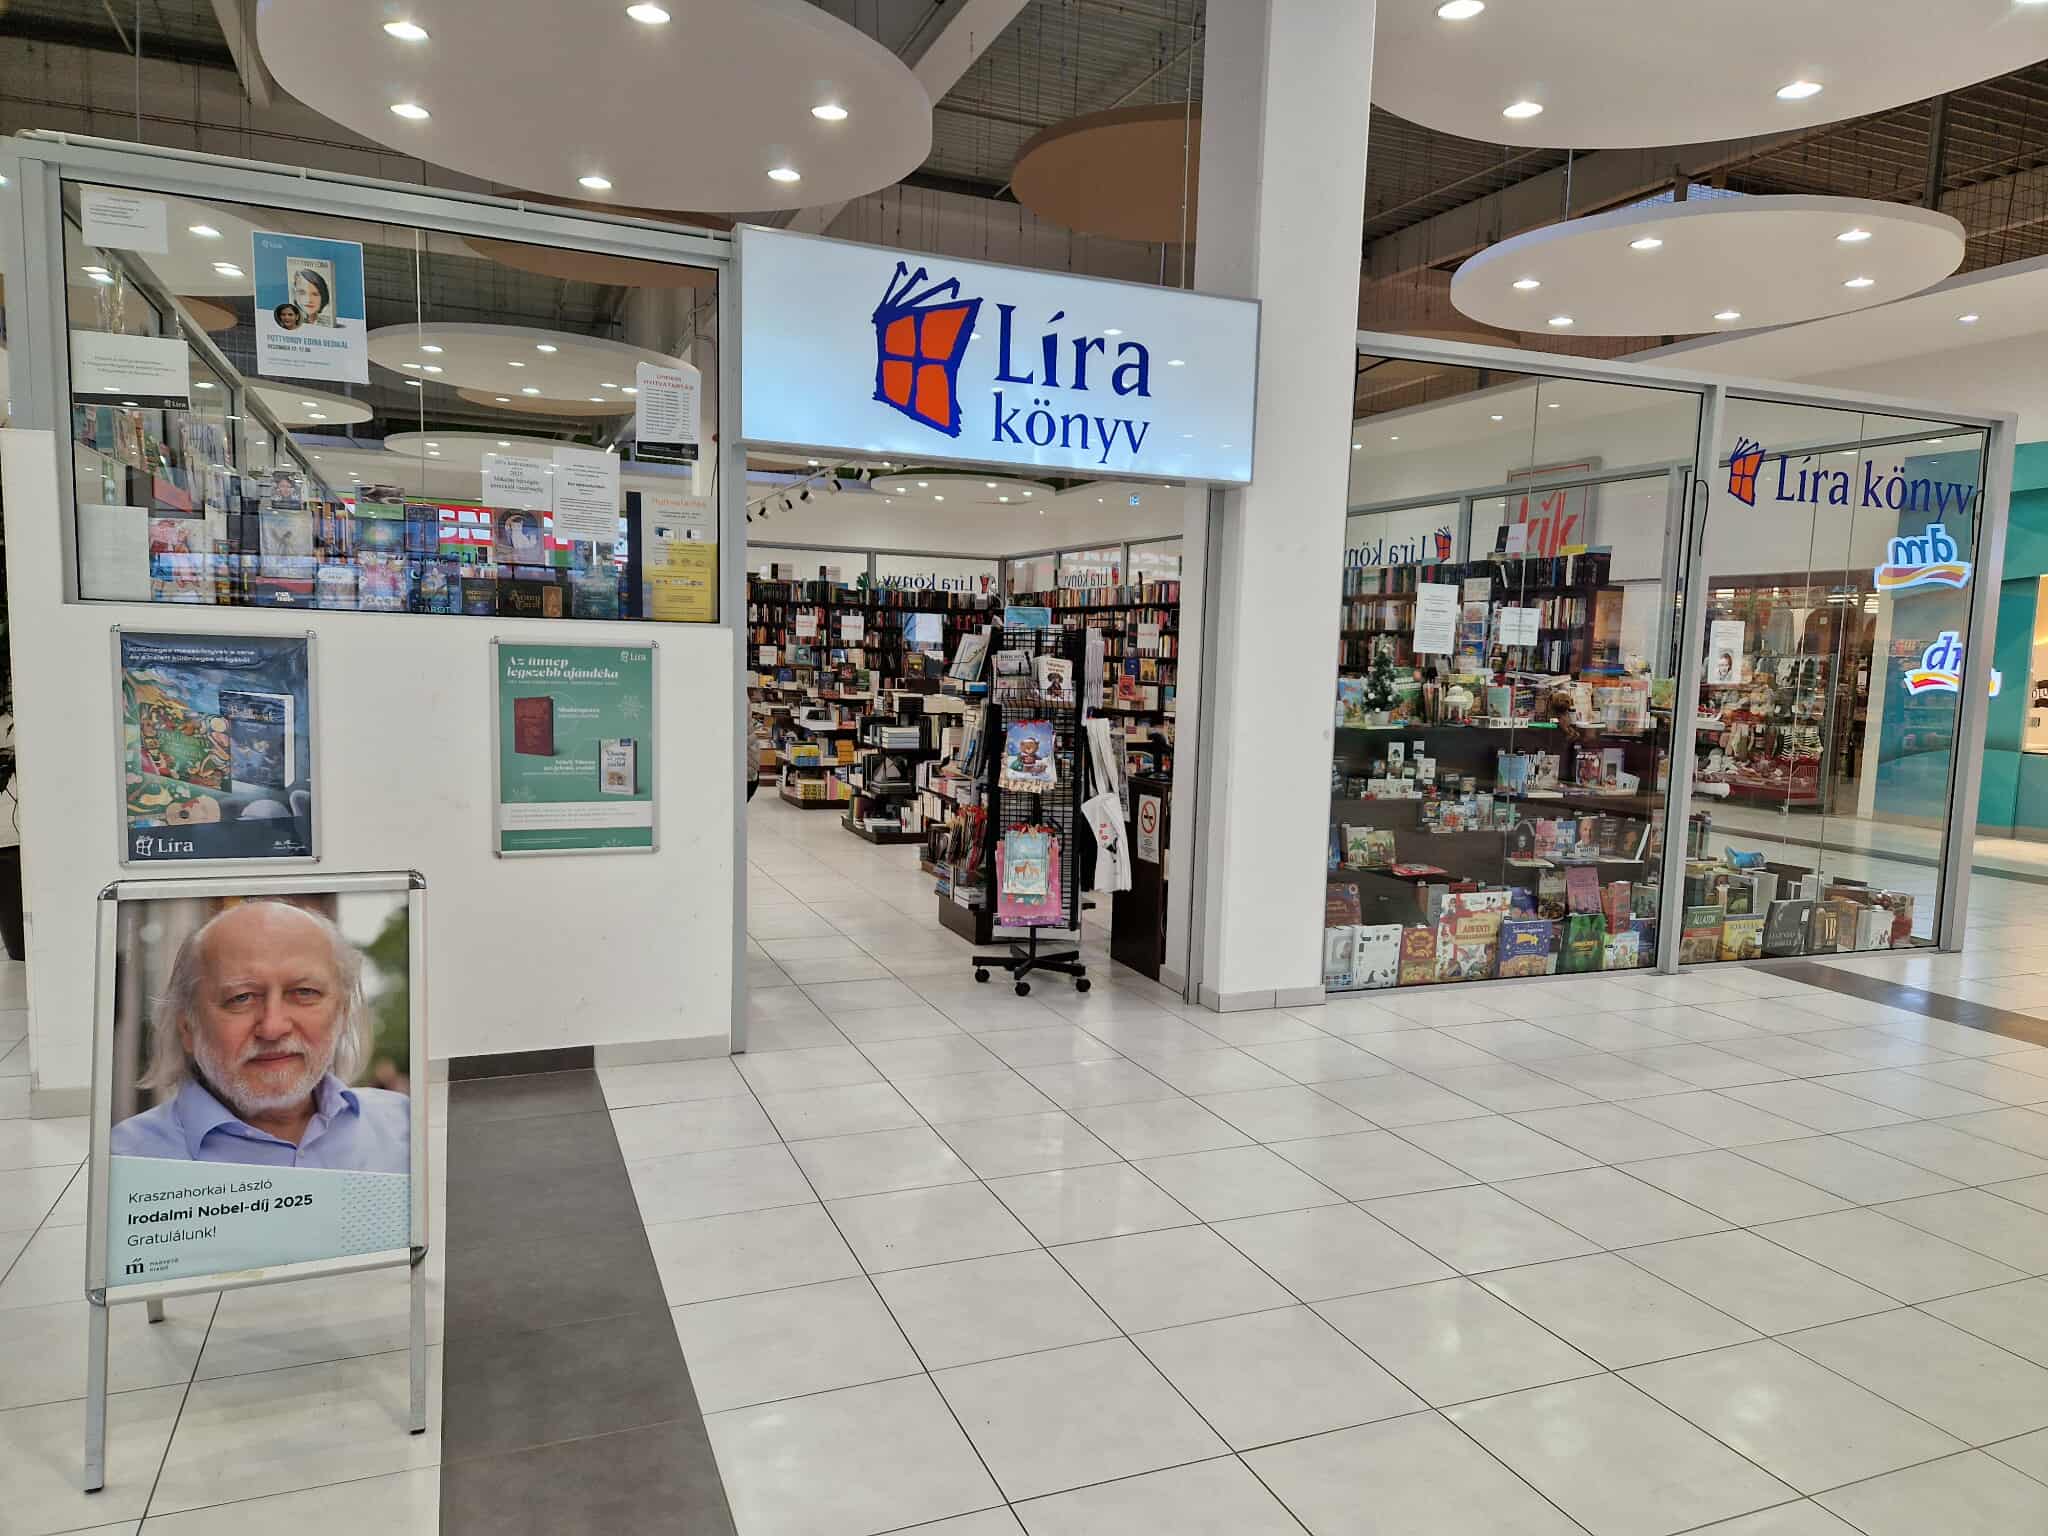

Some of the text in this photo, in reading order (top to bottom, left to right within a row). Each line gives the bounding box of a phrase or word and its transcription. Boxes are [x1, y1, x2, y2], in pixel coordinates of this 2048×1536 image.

[993, 302, 1151, 397] Líra
[992, 391, 1151, 464] könyv
[1776, 455, 1974, 525] Líra könyv
[507, 666, 619, 681] legszebb ajándéka
[157, 838, 194, 853] Líra
[128, 1178, 273, 1204] Krasznahorkai László
[128, 1194, 313, 1225] Irodalmi Nobel-díj 2025
[128, 1226, 216, 1247] Gratulálunk!
